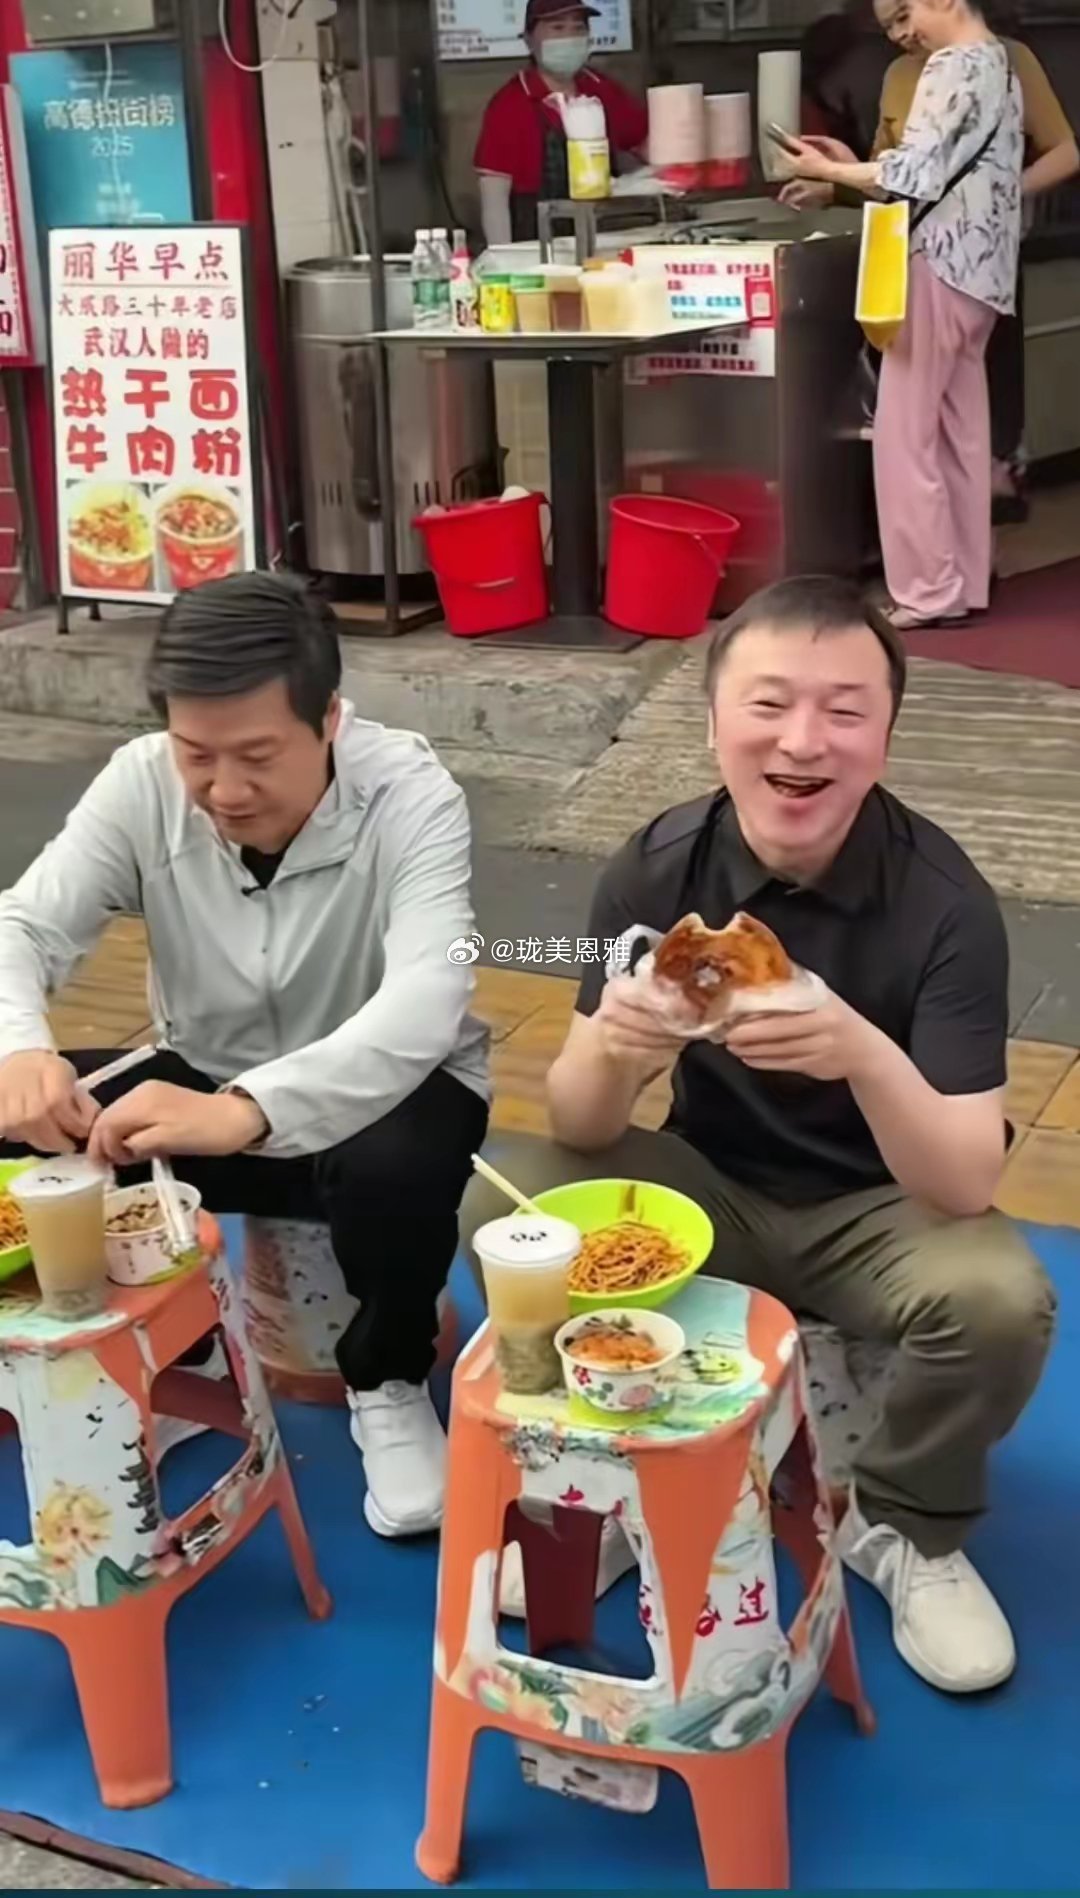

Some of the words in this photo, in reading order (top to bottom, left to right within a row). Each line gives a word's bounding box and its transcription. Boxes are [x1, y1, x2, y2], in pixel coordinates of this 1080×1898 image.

[61, 241, 229, 281] 丽华早点
[83, 326, 209, 360] 武汉人做的
[60, 365, 239, 421] 热干面
[66, 424, 242, 477] 牛肉粉
